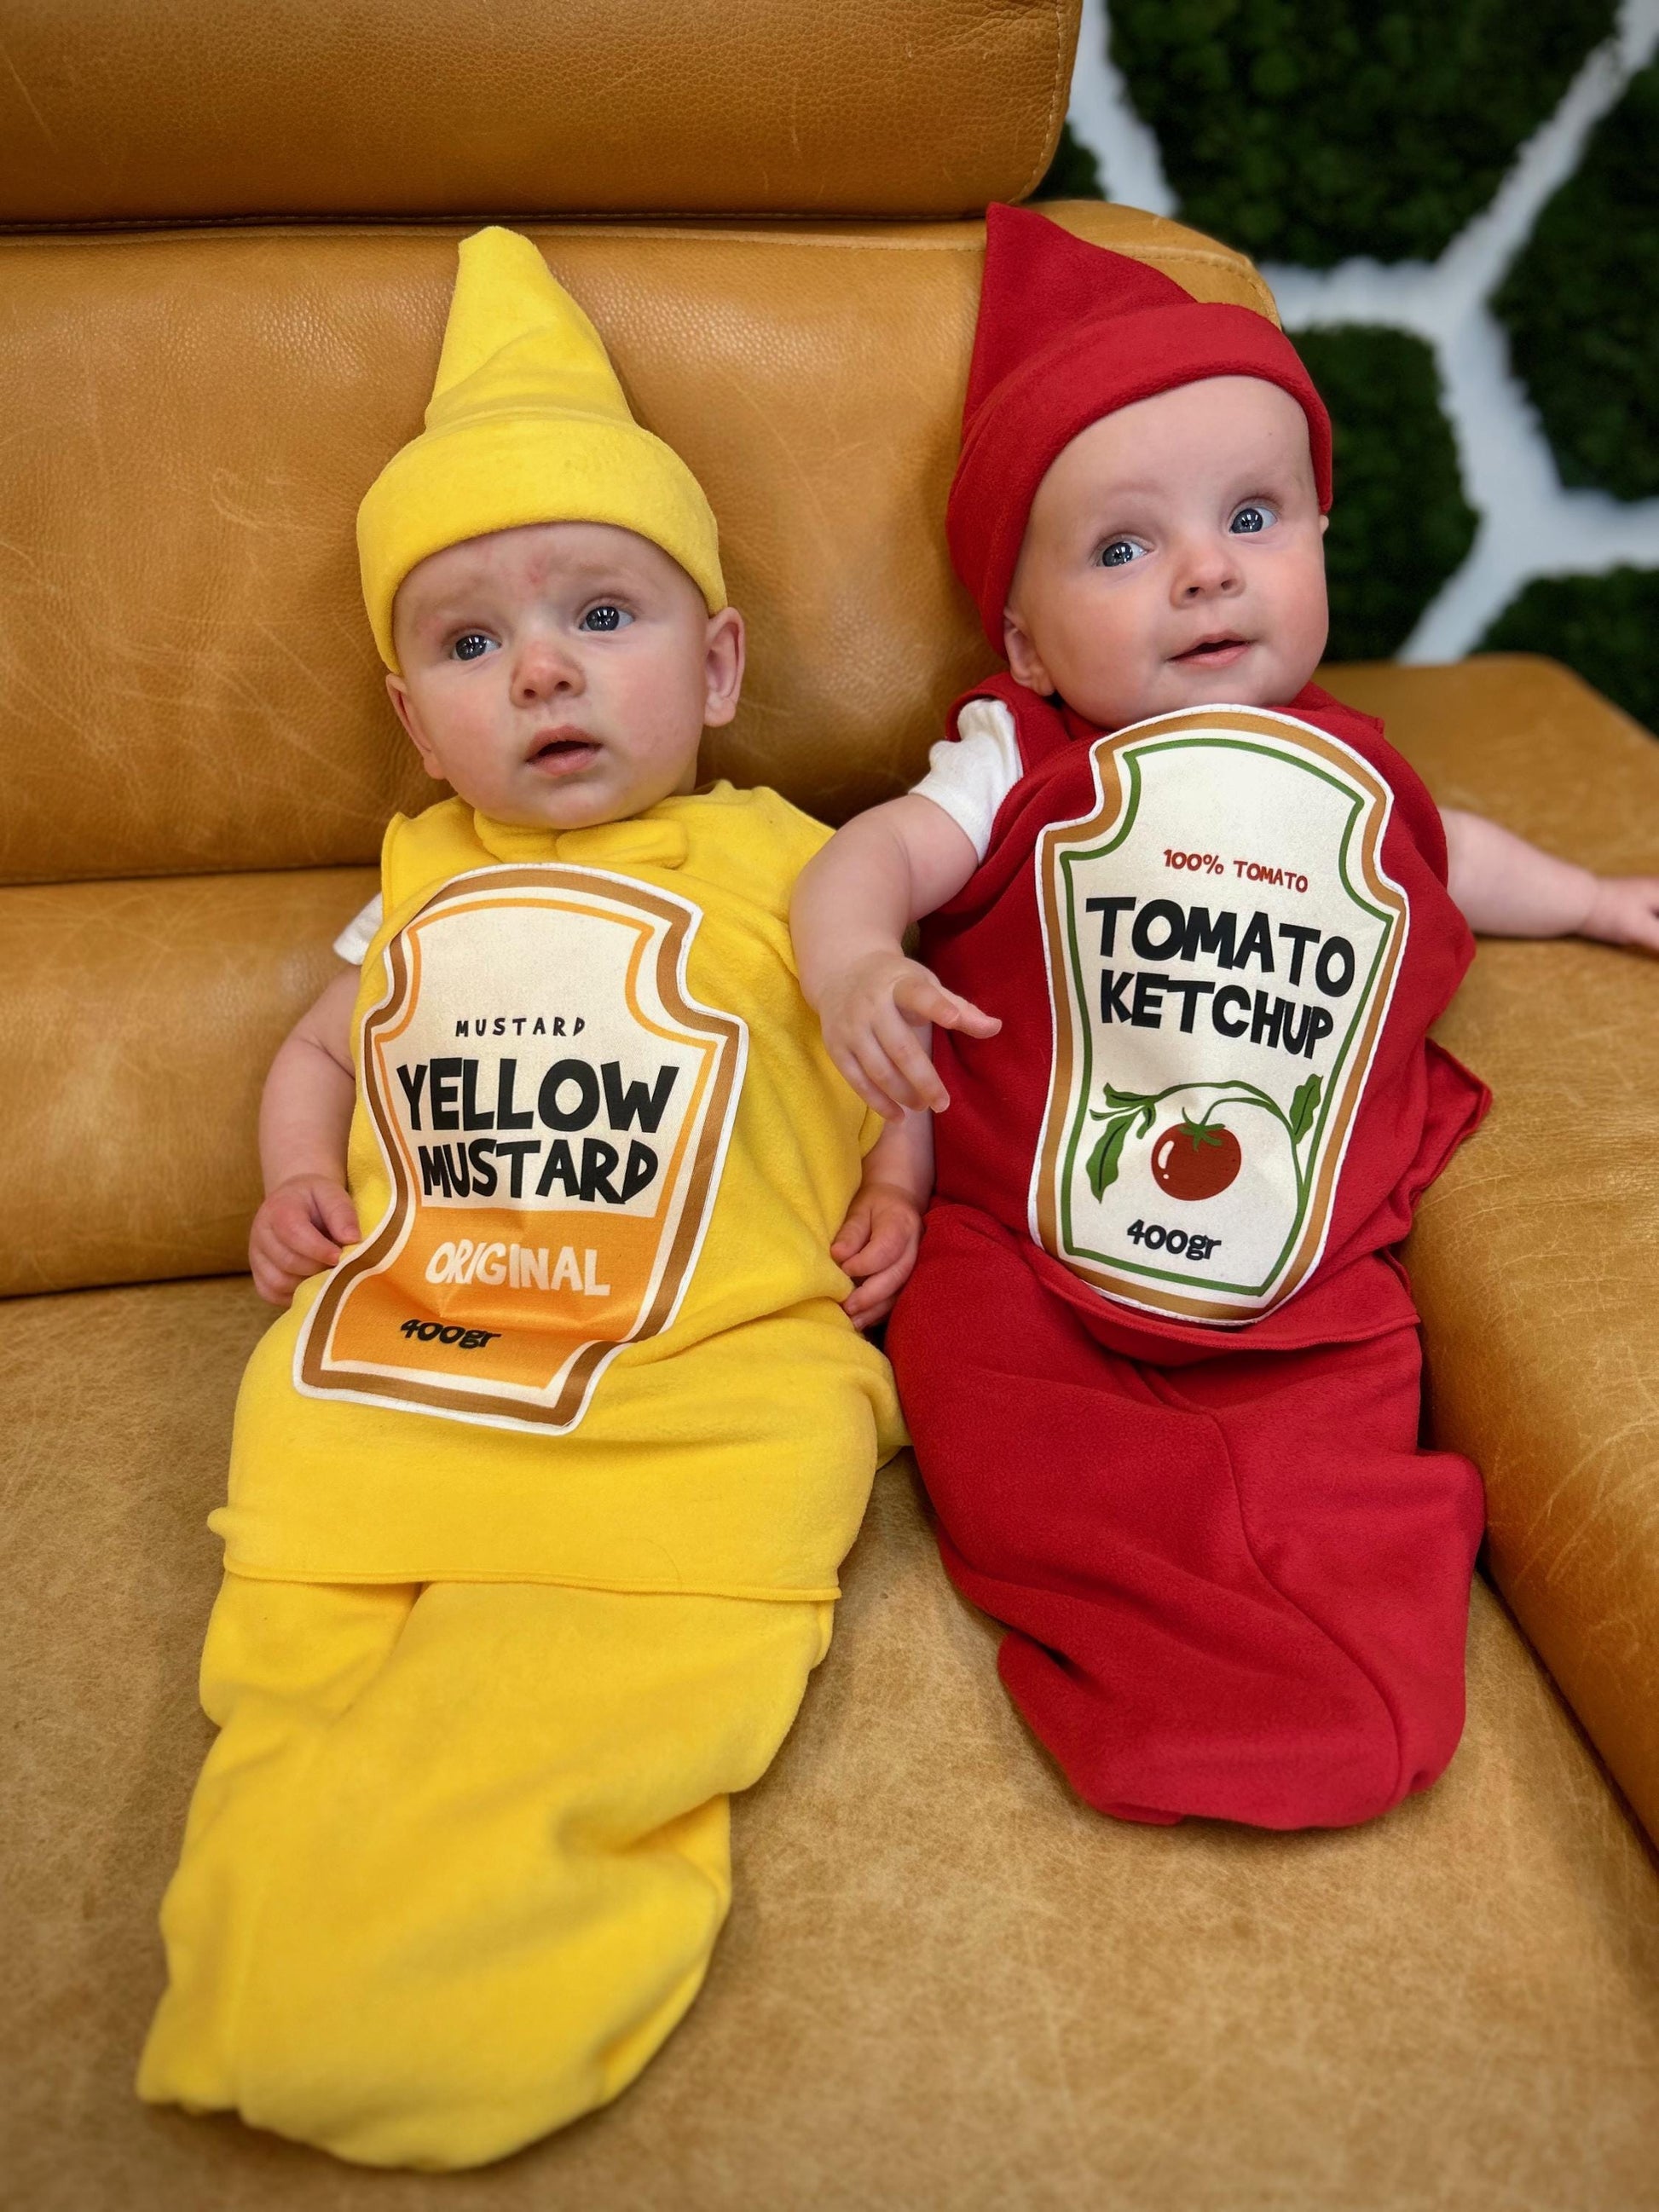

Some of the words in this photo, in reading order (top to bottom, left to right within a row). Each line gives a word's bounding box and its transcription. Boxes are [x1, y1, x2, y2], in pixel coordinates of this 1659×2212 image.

[1162, 848, 1224, 875] 100%
[1233, 860, 1309, 893] TOMATO
[1085, 896, 1356, 998] TOMATO
[455, 1016, 587, 1037] MUSTARD
[1100, 968, 1334, 1060] KETCHUP
[396, 1057, 680, 1134] YELLOW
[417, 1137, 659, 1204] MUSTARD
[425, 1239, 610, 1296] ORIGINAL
[1126, 1218, 1222, 1262] 400gr
[399, 1319, 502, 1349] 400gr
